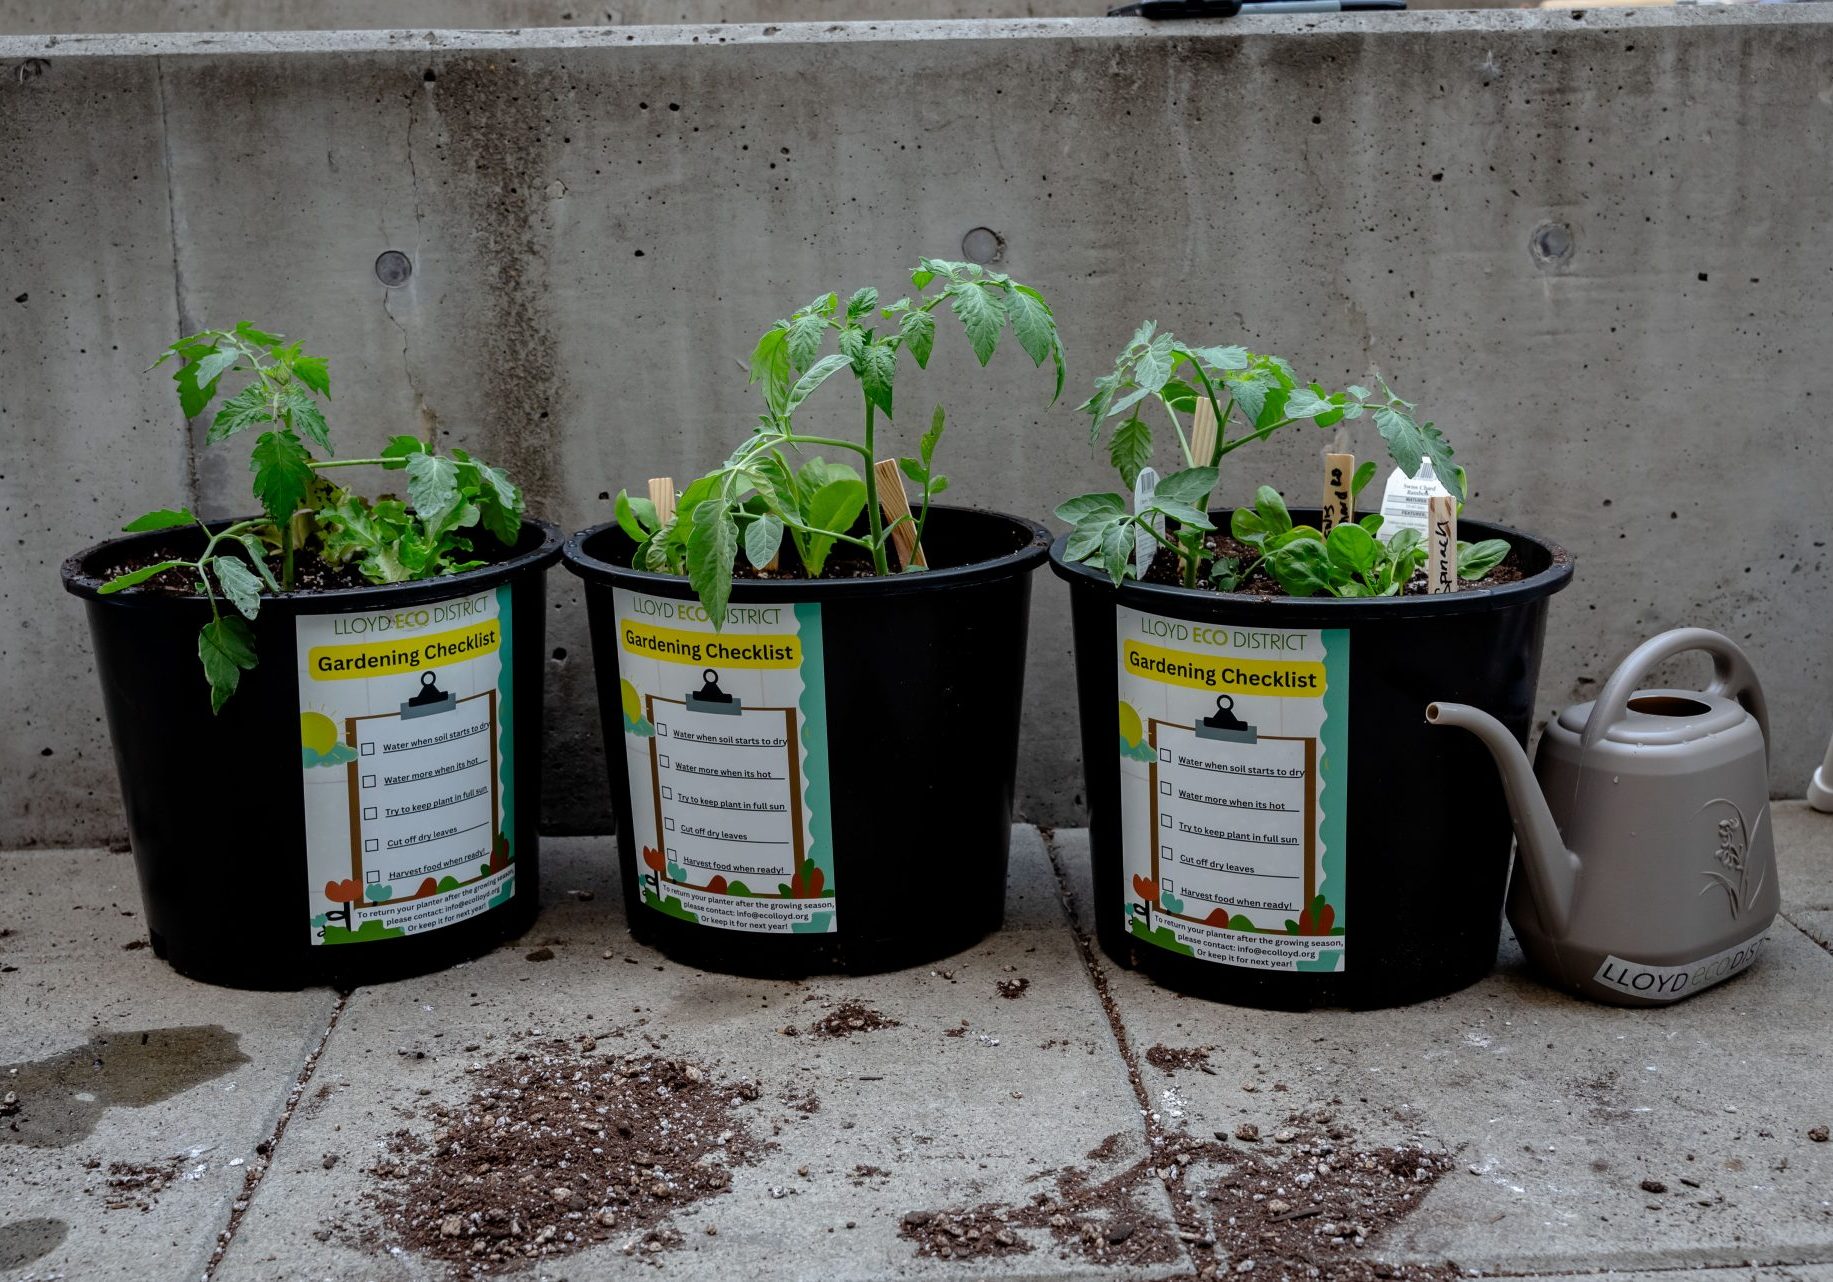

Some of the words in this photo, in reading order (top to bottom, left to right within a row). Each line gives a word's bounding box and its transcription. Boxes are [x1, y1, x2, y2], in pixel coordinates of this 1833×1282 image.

[334, 616, 390, 635] LLOYD
[395, 610, 430, 629] ECO
[434, 596, 488, 623] DISTRICT
[633, 596, 673, 618] LLOYD
[678, 605, 709, 622] ECO
[727, 608, 781, 624] ISTRICT
[1141, 617, 1188, 641] LLOYD
[1193, 627, 1228, 646] ECO
[1234, 632, 1307, 650] DISTRICT
[318, 649, 420, 671] Gardening
[425, 630, 496, 660] Checklist
[626, 629, 701, 661] Gardening
[706, 644, 793, 660] Checklist
[1130, 651, 1216, 686] Gardening
[1222, 668, 1316, 688] Checklist
[383, 742, 409, 751] Water
[411, 737, 432, 747] when
[435, 733, 448, 742] soil
[449, 729, 469, 739] starts
[673, 729, 694, 739] Water
[696, 734, 716, 742] when
[773, 738, 787, 747] dry
[384, 773, 412, 784] Water
[412, 770, 432, 779] more
[435, 764, 455, 775] when
[467, 758, 478, 767] hot
[676, 762, 696, 771] Water
[721, 769, 742, 777] when
[1179, 756, 1203, 767] Water
[1205, 761, 1227, 771] when
[1230, 765, 1246, 773] soil
[1248, 767, 1274, 775] starts
[1277, 768, 1286, 776] to
[1289, 769, 1305, 778] dry
[385, 808, 399, 816] Try
[433, 797, 453, 807] plant
[463, 789, 475, 799] full
[476, 786, 487, 794] sun
[678, 793, 689, 802] Try
[700, 797, 718, 807] keep
[721, 800, 741, 808] plant
[753, 802, 767, 810] full
[1179, 789, 1203, 800] Water
[1205, 796, 1227, 804] more
[1229, 799, 1253, 807] when
[1256, 801, 1266, 809] its
[1269, 802, 1285, 810] hot
[387, 838, 402, 847] Cut
[405, 836, 417, 844] off
[418, 833, 431, 842] dry
[433, 827, 457, 837] leaves
[681, 825, 693, 833] Cut
[707, 830, 719, 839] dry
[722, 831, 747, 840] leaves
[1179, 822, 1191, 832] Try
[1205, 827, 1224, 838] keep
[1227, 831, 1250, 840] plant
[1252, 833, 1260, 841] in
[1263, 834, 1278, 843] full
[389, 867, 421, 878] Harvest
[424, 862, 441, 872] food
[444, 856, 463, 866] when
[683, 856, 711, 868] Harvest
[713, 862, 731, 870] food
[757, 866, 784, 874] ready!
[1180, 855, 1194, 863] Cut
[1210, 861, 1224, 871] dry
[1226, 863, 1254, 873] leaves
[370, 908, 395, 917] return
[397, 905, 414, 914] your
[417, 897, 443, 910] planter
[444, 893, 460, 902] after
[462, 888, 473, 896] the
[473, 879, 496, 894] growing
[663, 884, 670, 892] To
[671, 888, 690, 898] return
[692, 894, 706, 903] your
[708, 896, 733, 906] planter
[735, 899, 754, 907] after
[770, 902, 802, 911] growing
[804, 901, 834, 909] season,
[1181, 886, 1212, 900] Harvest
[1215, 894, 1234, 903] food
[1236, 898, 1260, 907] when
[1263, 901, 1292, 910] ready!
[386, 916, 412, 927] please
[414, 908, 444, 920] contact:
[419, 920, 436, 930] keep
[444, 914, 454, 922] for
[456, 910, 470, 919] next
[684, 902, 704, 911] please
[706, 907, 735, 917] contact:
[737, 910, 809, 920] info@ecolloyd.org
[711, 916, 728, 926] keep
[768, 923, 788, 931] year!
[1155, 915, 1163, 923] To
[1164, 919, 1186, 931] return
[1188, 926, 1204, 935] your
[1206, 930, 1235, 940] planter
[1237, 935, 1256, 943] after
[1259, 936, 1272, 945] the
[1275, 938, 1309, 948] growing
[1311, 940, 1344, 948] season,
[1178, 933, 1201, 944] please
[1203, 940, 1236, 951] contact:
[1237, 944, 1315, 959] info@ecolloyd.org
[1197, 948, 1206, 956] Or
[1208, 951, 1227, 961] keep
[1236, 955, 1248, 963] for
[1250, 957, 1269, 965] next
[1270, 960, 1292, 968] year!
